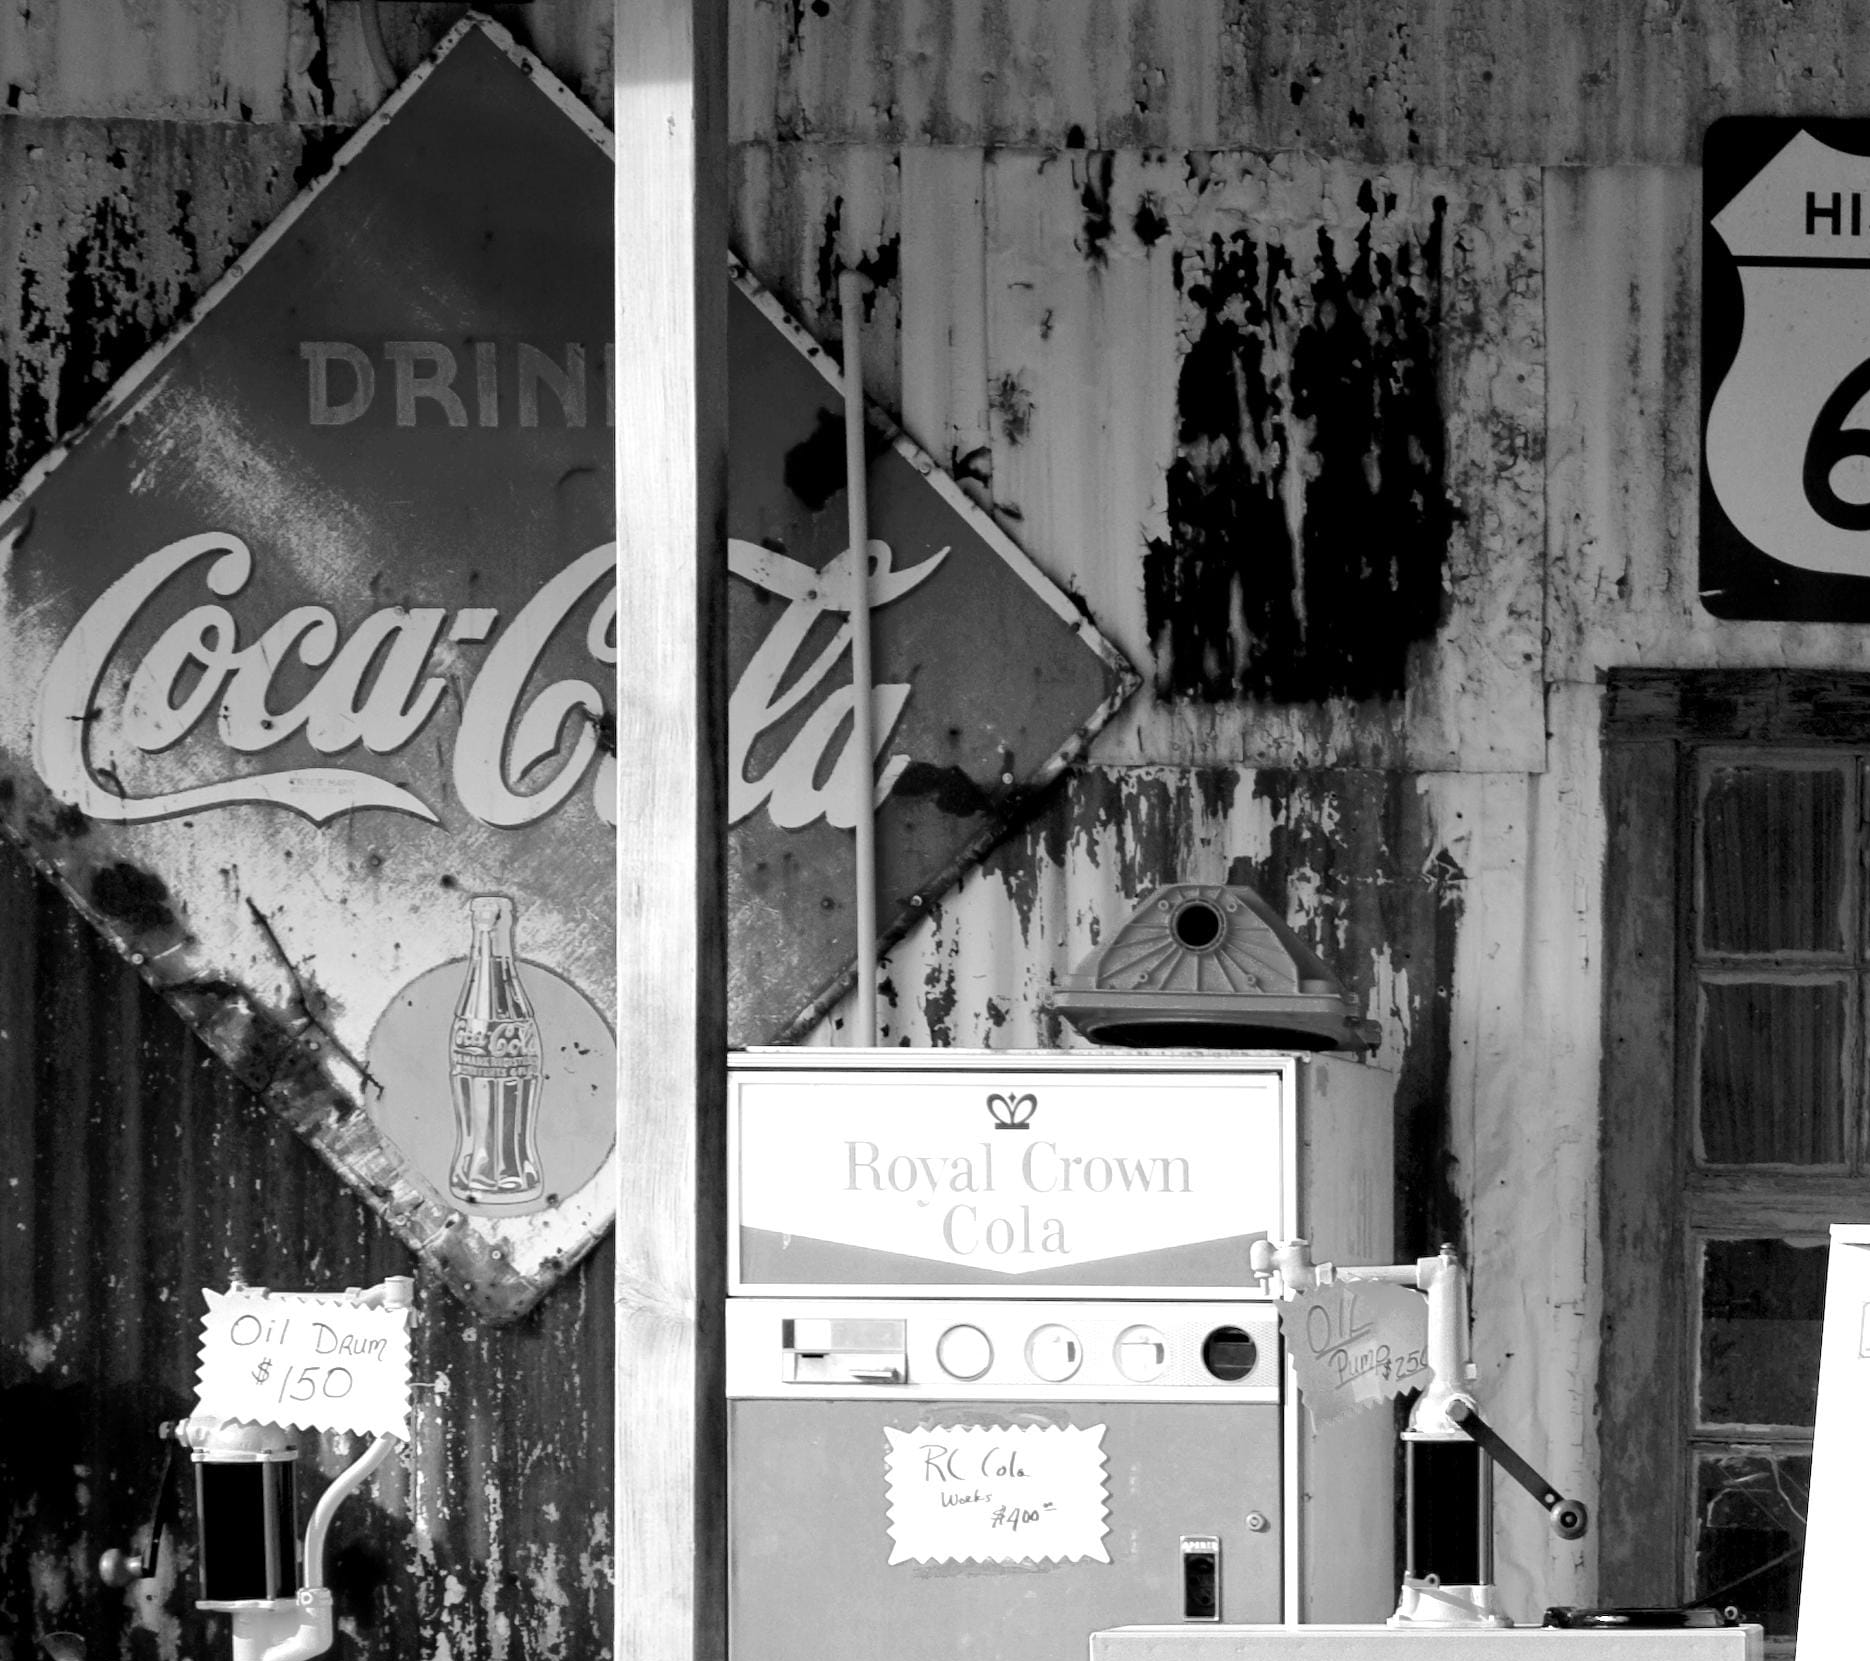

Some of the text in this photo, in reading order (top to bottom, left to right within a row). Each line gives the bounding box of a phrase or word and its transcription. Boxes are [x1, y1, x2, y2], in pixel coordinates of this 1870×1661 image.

[300, 340, 615, 428] DRIN
[34, 530, 951, 828] Coca-Cla
[843, 1139, 1195, 1207] Royal Crown
[941, 1204, 1072, 1255] Cola
[229, 1314, 291, 1346] Oil
[1306, 1294, 1375, 1353] OIL
[250, 1355, 353, 1404] $150
[920, 1444, 1031, 1482] RC Cola
